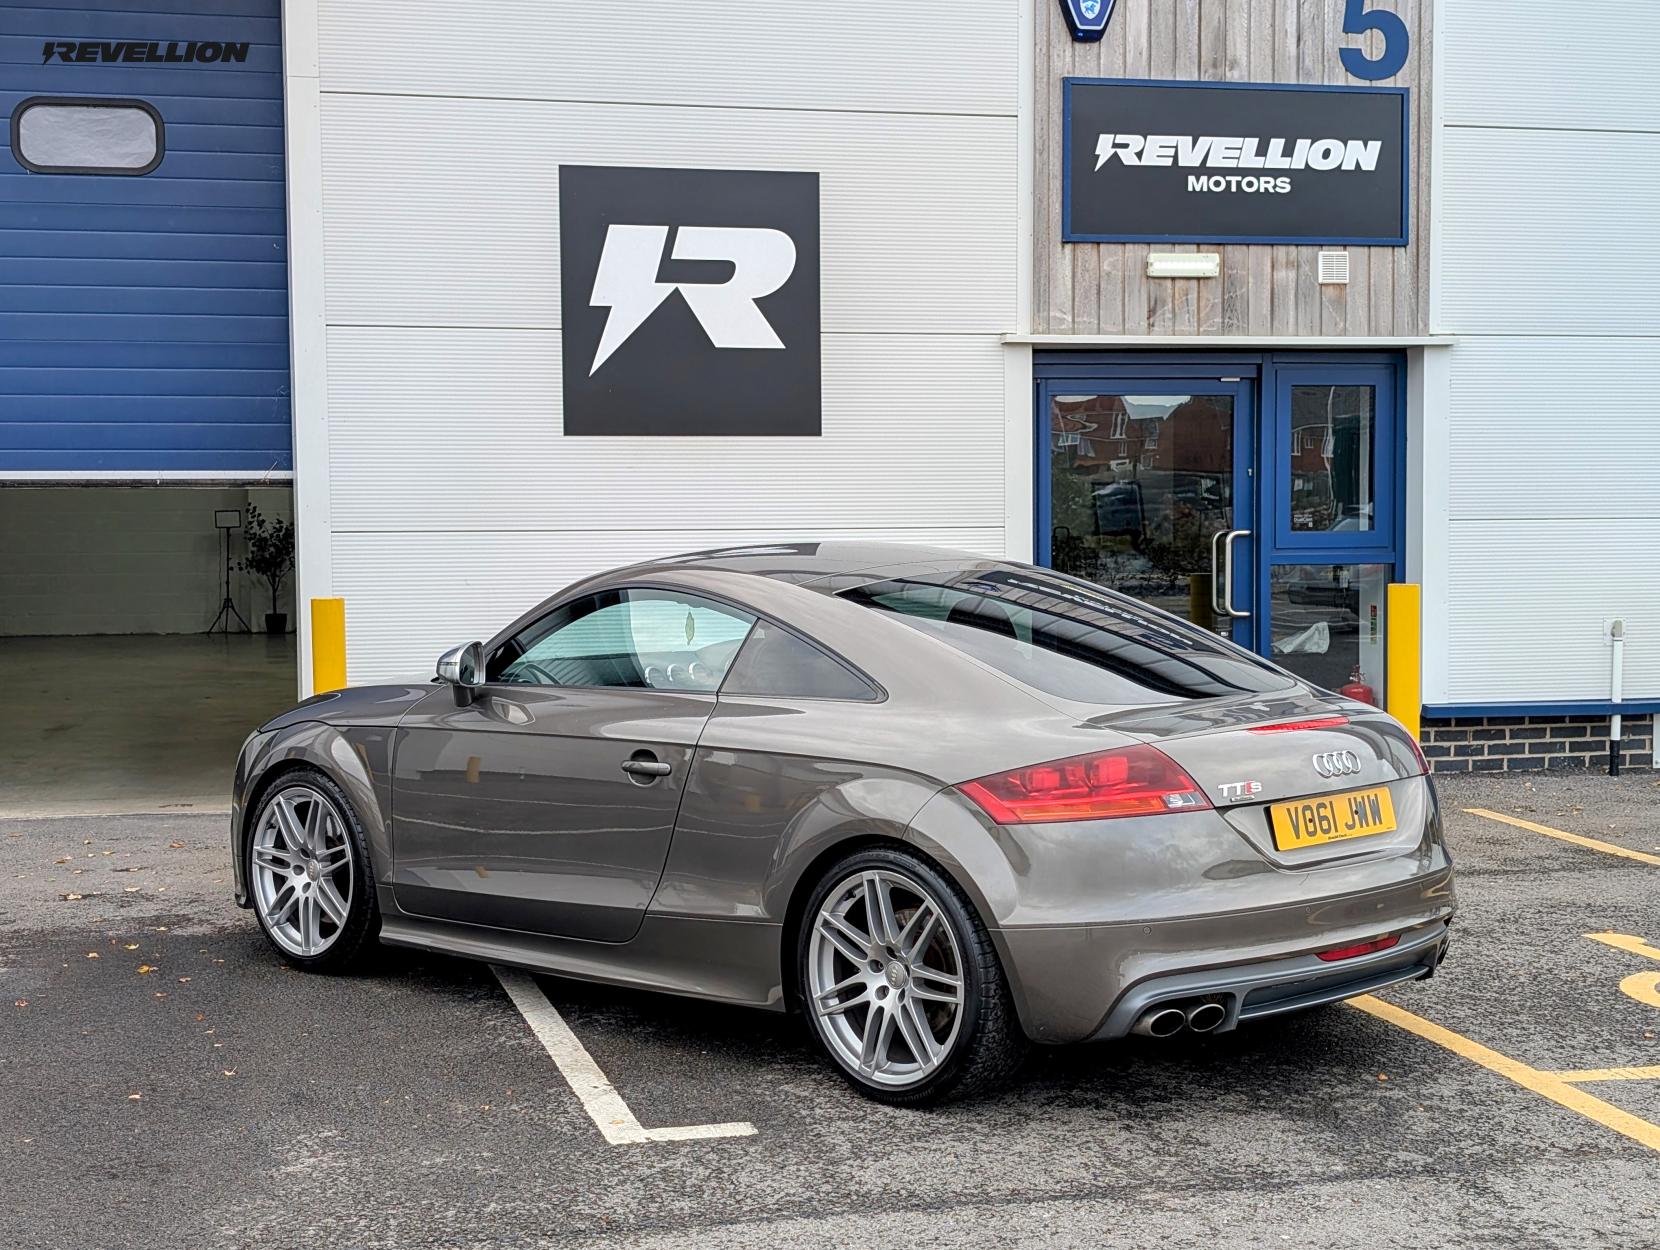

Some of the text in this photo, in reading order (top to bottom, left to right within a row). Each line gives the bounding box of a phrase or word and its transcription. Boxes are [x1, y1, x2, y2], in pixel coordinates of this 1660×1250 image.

[1339, 0, 1409, 81] 5
[1094, 133, 1382, 172] REVELLION
[1187, 175, 1292, 194] MOTORS
[589, 224, 797, 378] R
[1218, 781, 1263, 797] TTS
[1344, 793, 1383, 831] JWW
